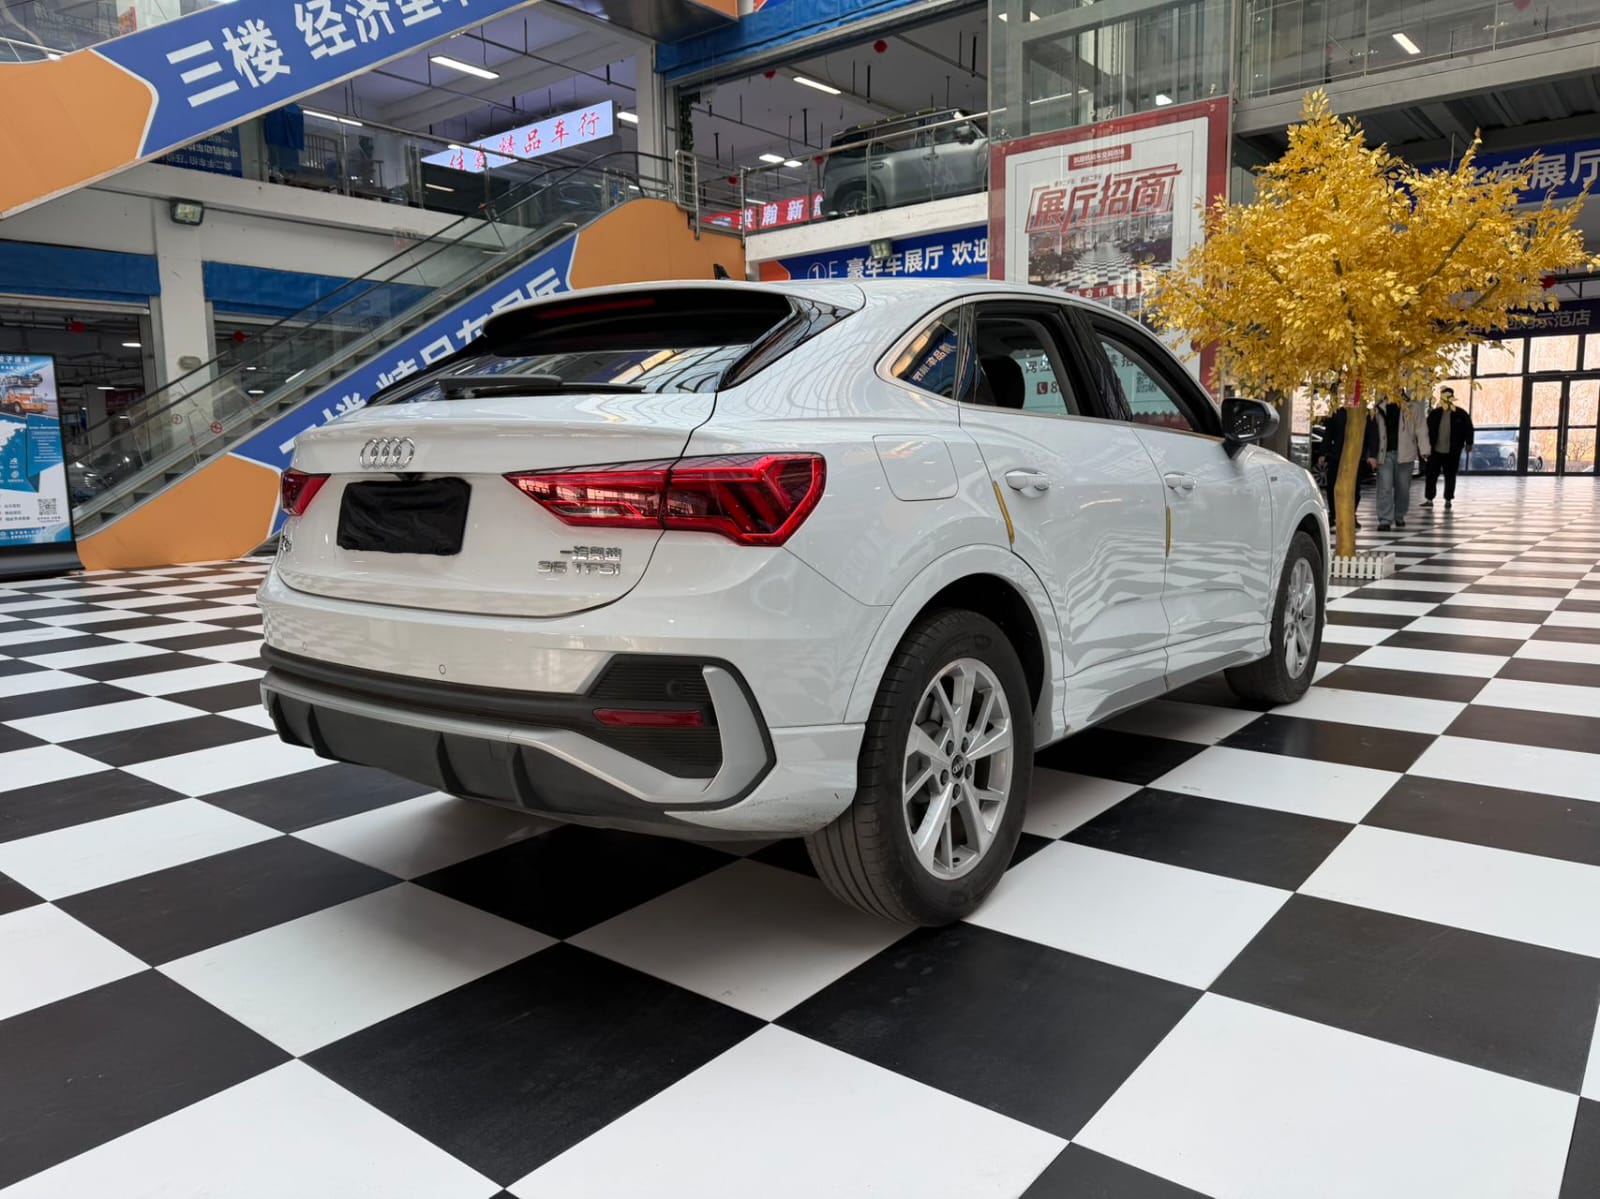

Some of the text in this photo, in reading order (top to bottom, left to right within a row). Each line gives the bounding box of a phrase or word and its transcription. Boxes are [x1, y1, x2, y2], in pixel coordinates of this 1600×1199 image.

[167, 0, 470, 107] 三楼 经济
[1034, 168, 1182, 231] 展厅招商
[846, 245, 944, 279] 豪华车展厅
